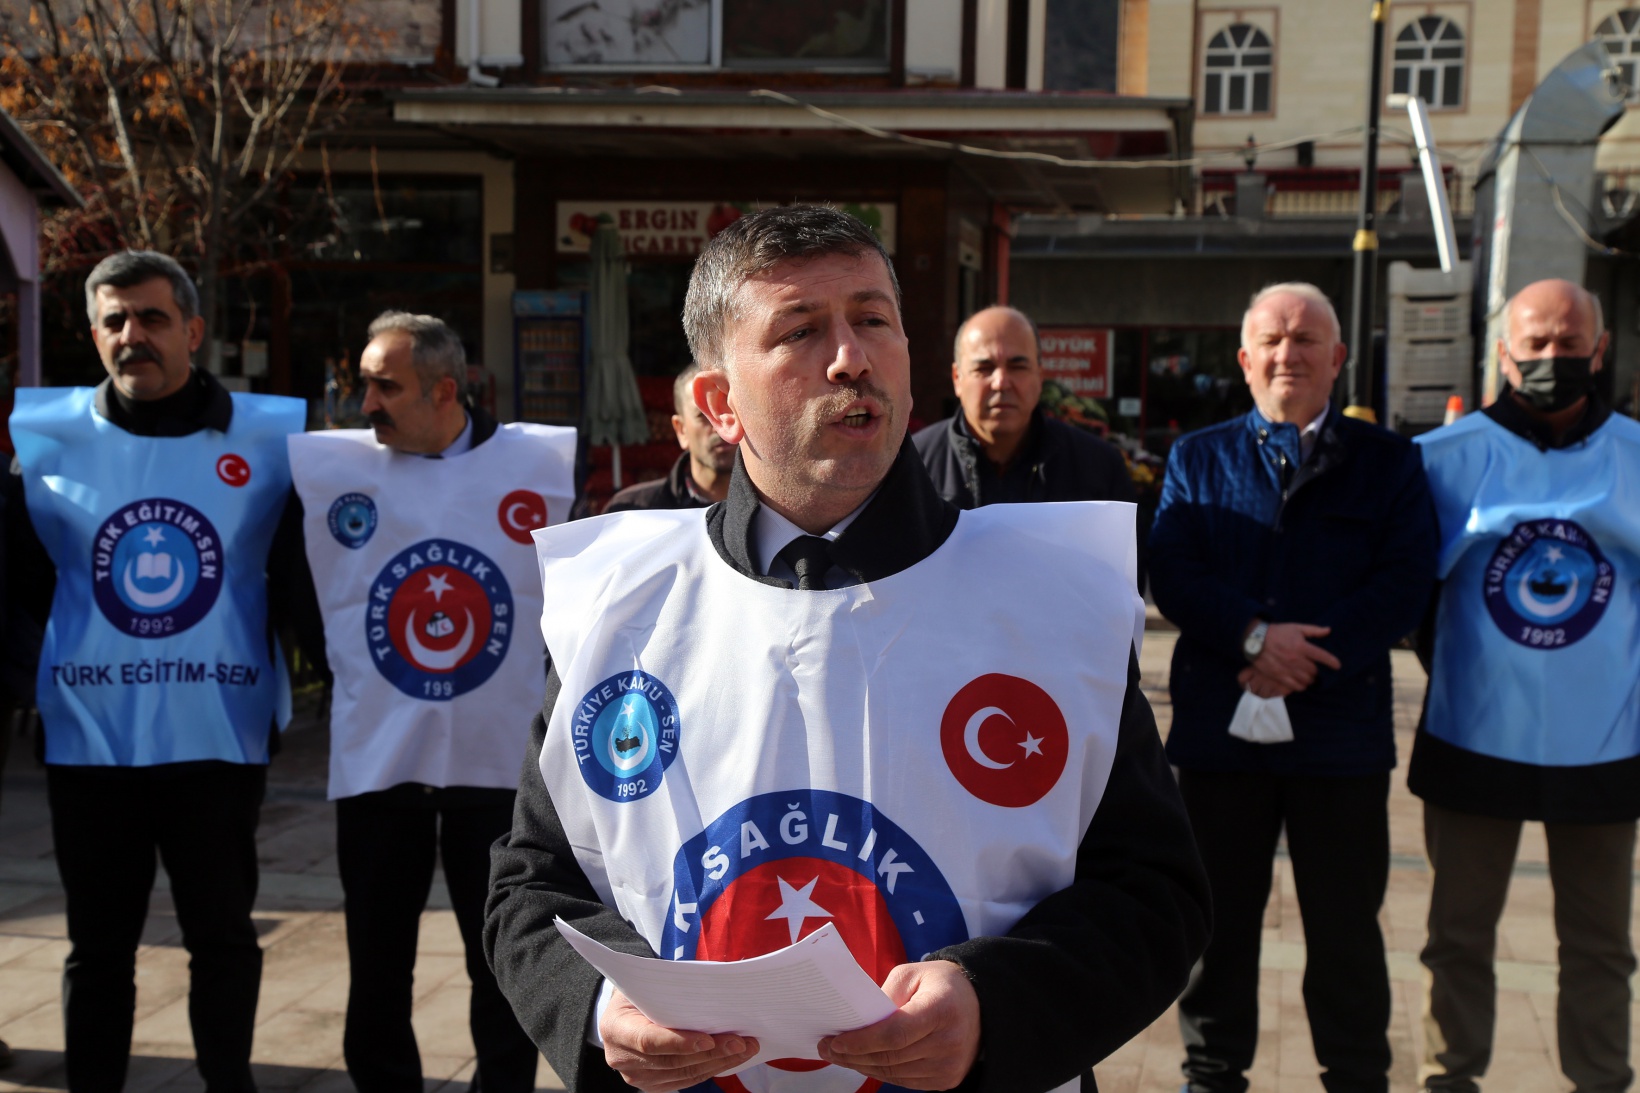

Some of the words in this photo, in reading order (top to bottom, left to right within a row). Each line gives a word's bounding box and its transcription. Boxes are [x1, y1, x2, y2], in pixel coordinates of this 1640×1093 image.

[1040, 335, 1097, 353] ÜYÜK
[370, 584, 393, 661] TÜRK
[391, 543, 491, 580] SAĞLIK
[486, 603, 508, 656] SEN
[130, 615, 175, 635] 1992
[1521, 626, 1567, 647] 1992
[51, 662, 114, 687] TÜRK
[120, 657, 260, 687] EĞİTİM-SEN
[423, 681, 454, 697] 199
[574, 685, 614, 766] TÜRKİYE
[617, 676, 663, 701] KAMU
[661, 715, 675, 754] SEN
[617, 779, 648, 798] 1992
[701, 802, 915, 895] SAĞLIK
